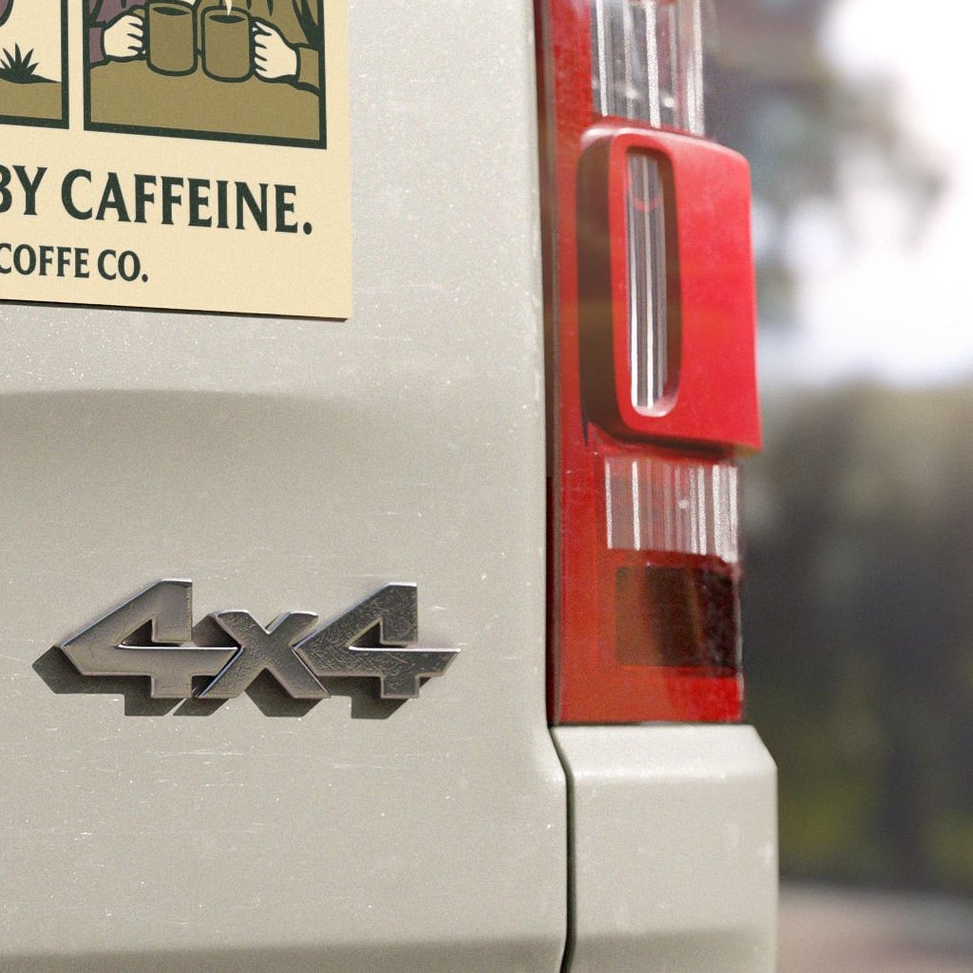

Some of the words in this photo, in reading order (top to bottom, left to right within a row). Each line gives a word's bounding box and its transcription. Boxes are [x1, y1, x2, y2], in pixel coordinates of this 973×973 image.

[61, 168, 314, 237] CAFFEINE.
[97, 249, 149, 283] CO.
[58, 577, 462, 699] 4x4
